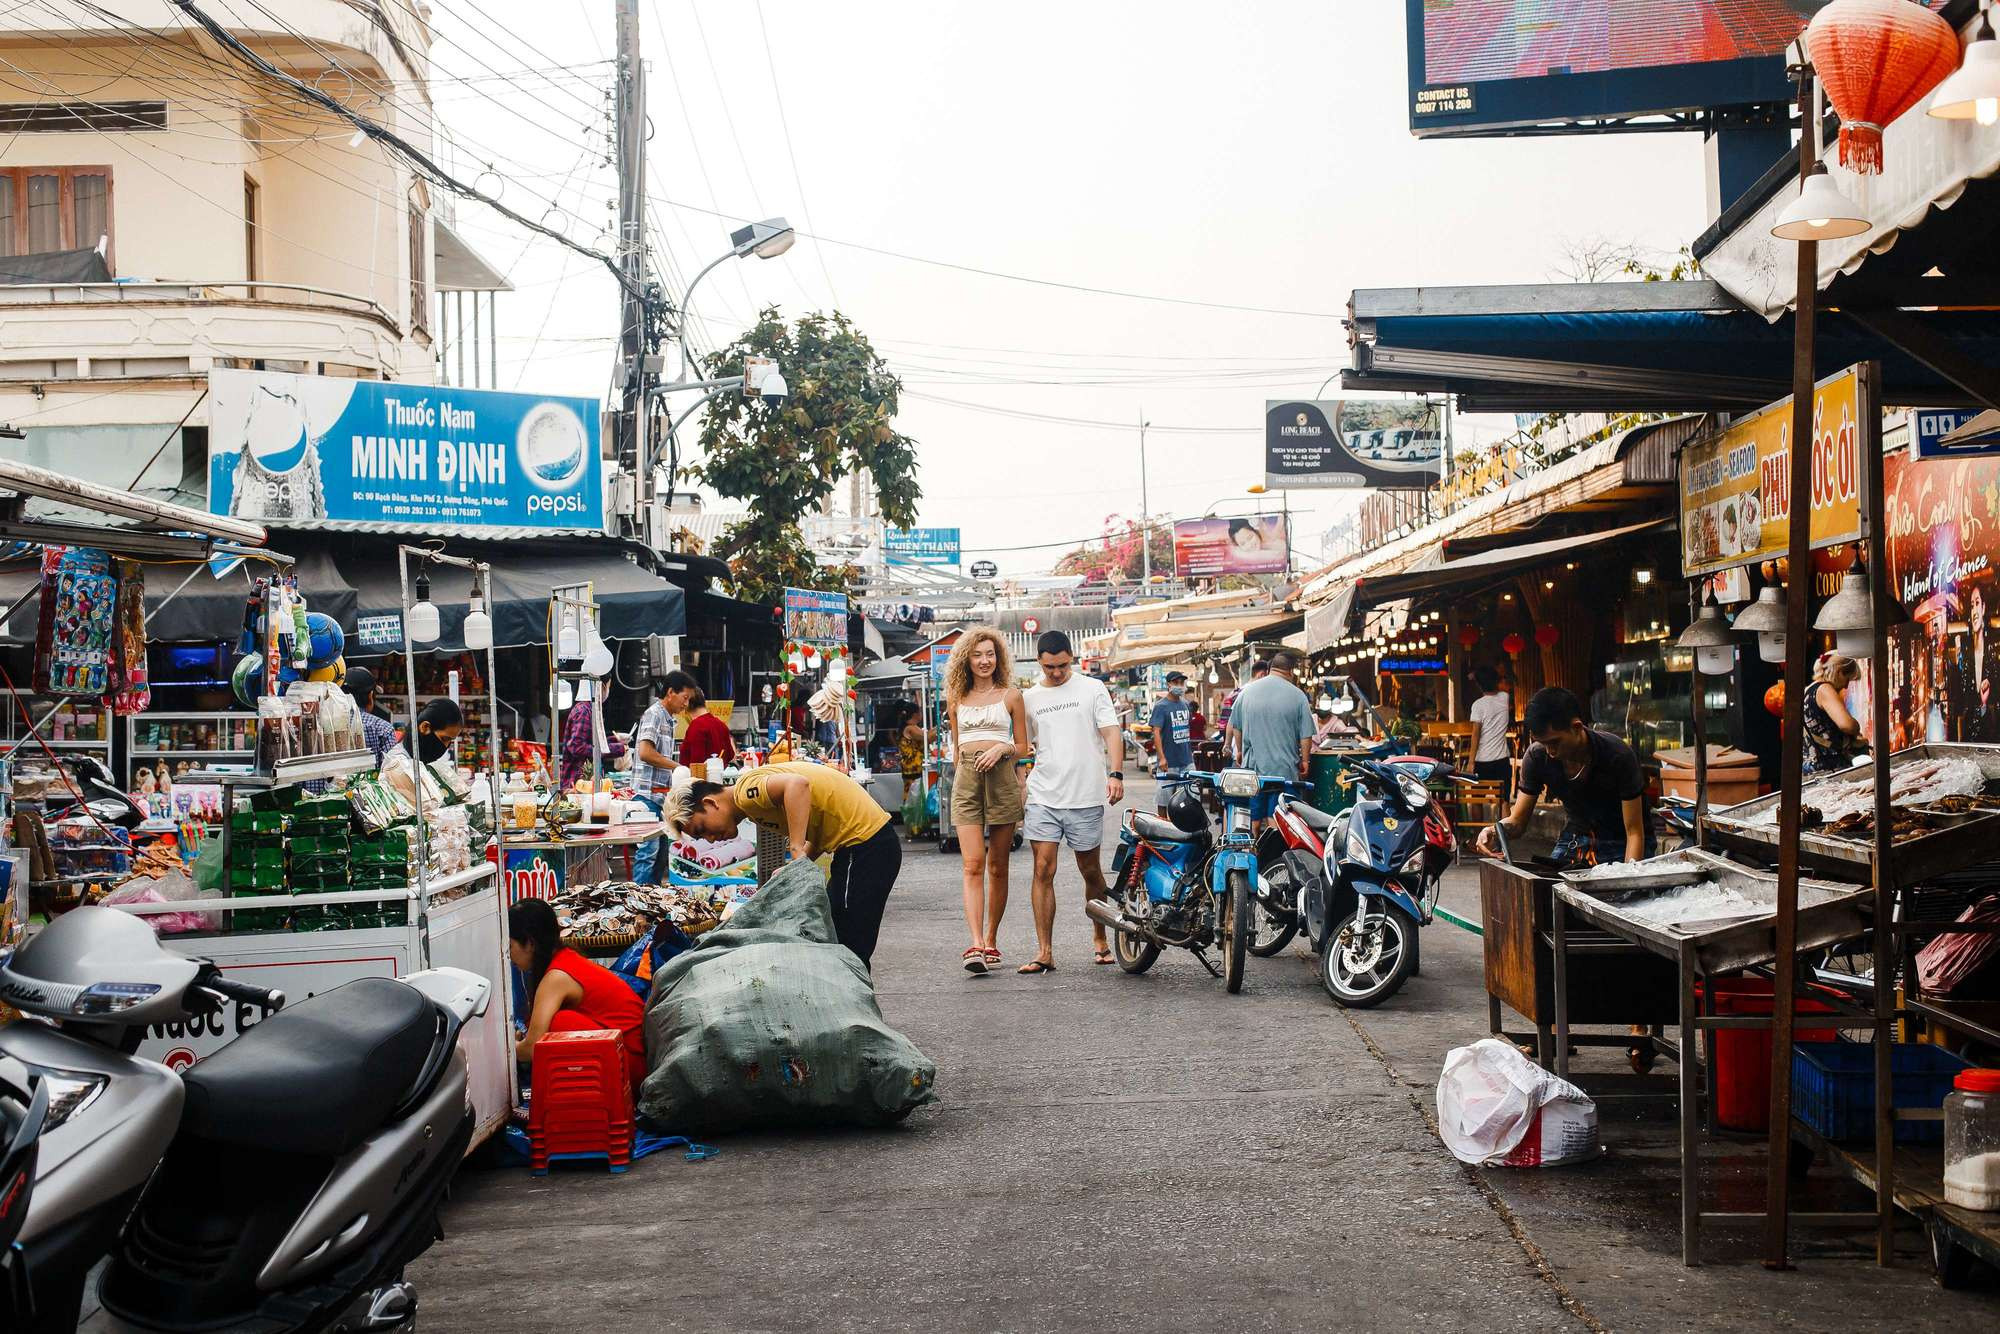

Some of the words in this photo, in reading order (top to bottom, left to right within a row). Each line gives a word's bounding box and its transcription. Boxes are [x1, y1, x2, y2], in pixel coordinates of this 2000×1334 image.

[1415, 102, 1437, 113] 0907
[1439, 100, 1454, 111] 114
[1417, 88, 1455, 101] CONTACT
[1456, 87, 1469, 98] US
[384, 398, 435, 427] Thuốc
[440, 402, 476, 429] Nam
[1281, 426, 1298, 434] LONG
[352, 435, 427, 481] MINH
[437, 440, 506, 492] ĐỊNH
[1728, 441, 1757, 481] SEAFOOD
[527, 492, 581, 516] pepsi
[1903, 560, 1931, 604] Island
[1932, 565, 1944, 593] of
[1945, 554, 1988, 583] Chance
